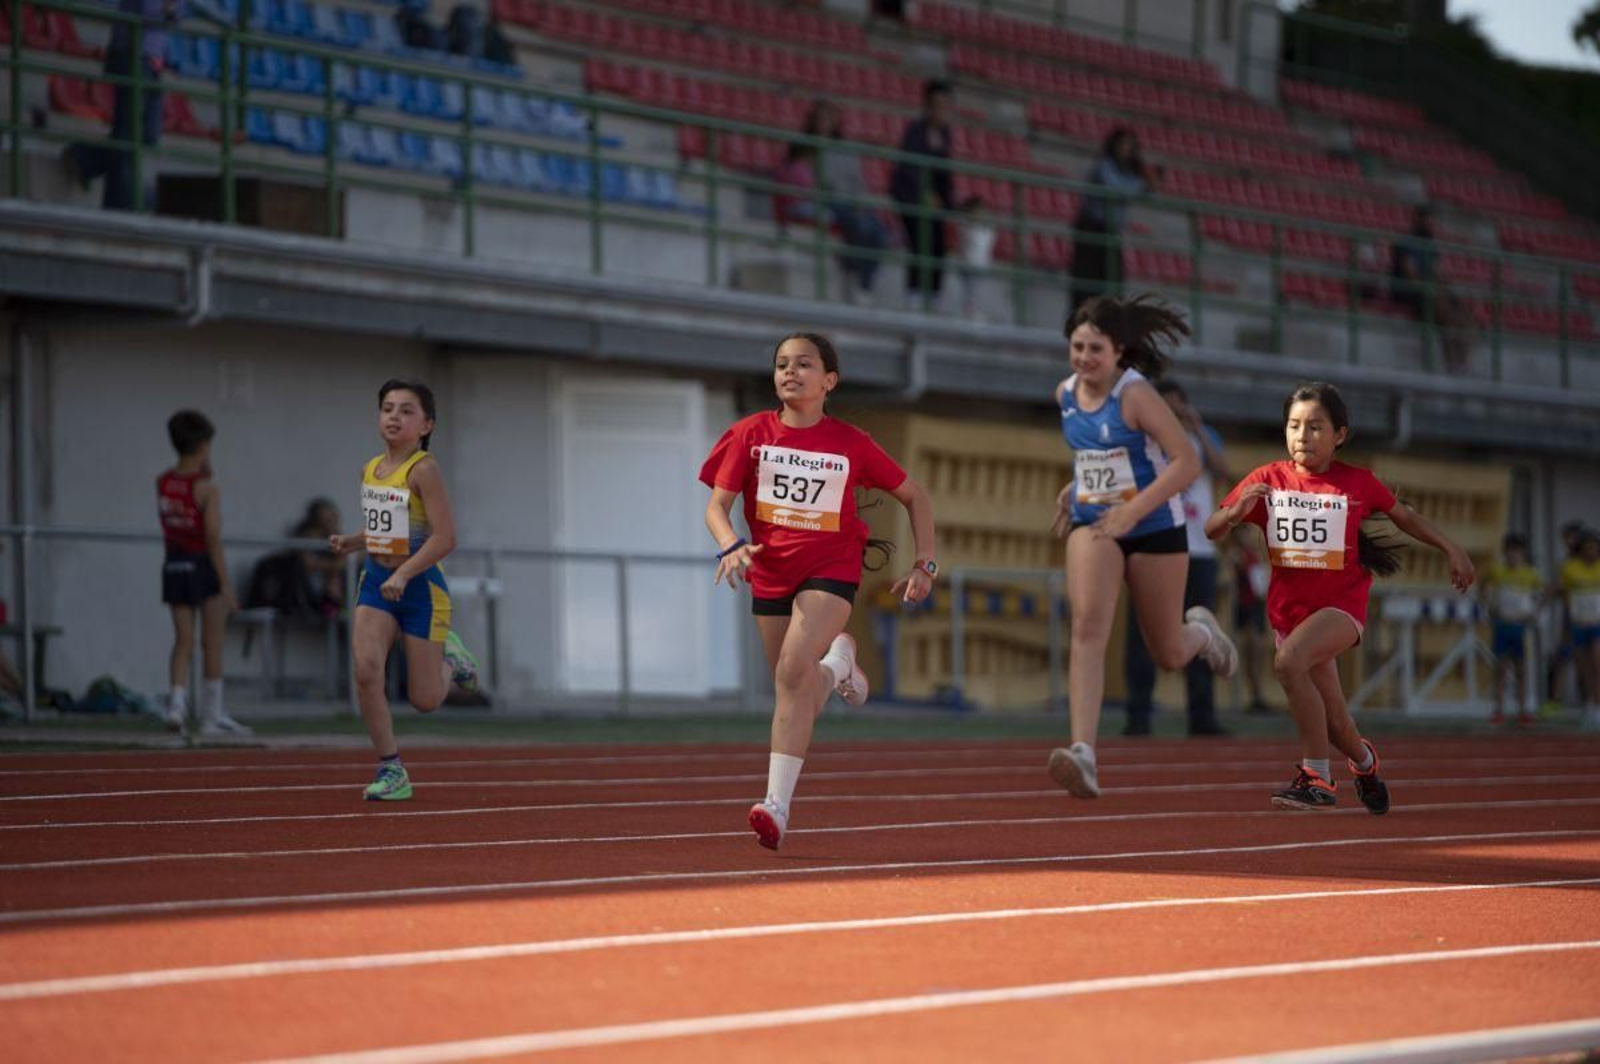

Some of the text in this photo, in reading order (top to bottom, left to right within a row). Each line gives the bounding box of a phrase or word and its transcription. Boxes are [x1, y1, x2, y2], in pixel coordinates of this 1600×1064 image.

[763, 451, 784, 463] La
[788, 454, 844, 471] Región
[772, 473, 826, 505] 537
[1083, 467, 1118, 490] 572
[1288, 496, 1342, 511] Región
[772, 515, 822, 530] telemiño
[1276, 517, 1328, 544] 565
